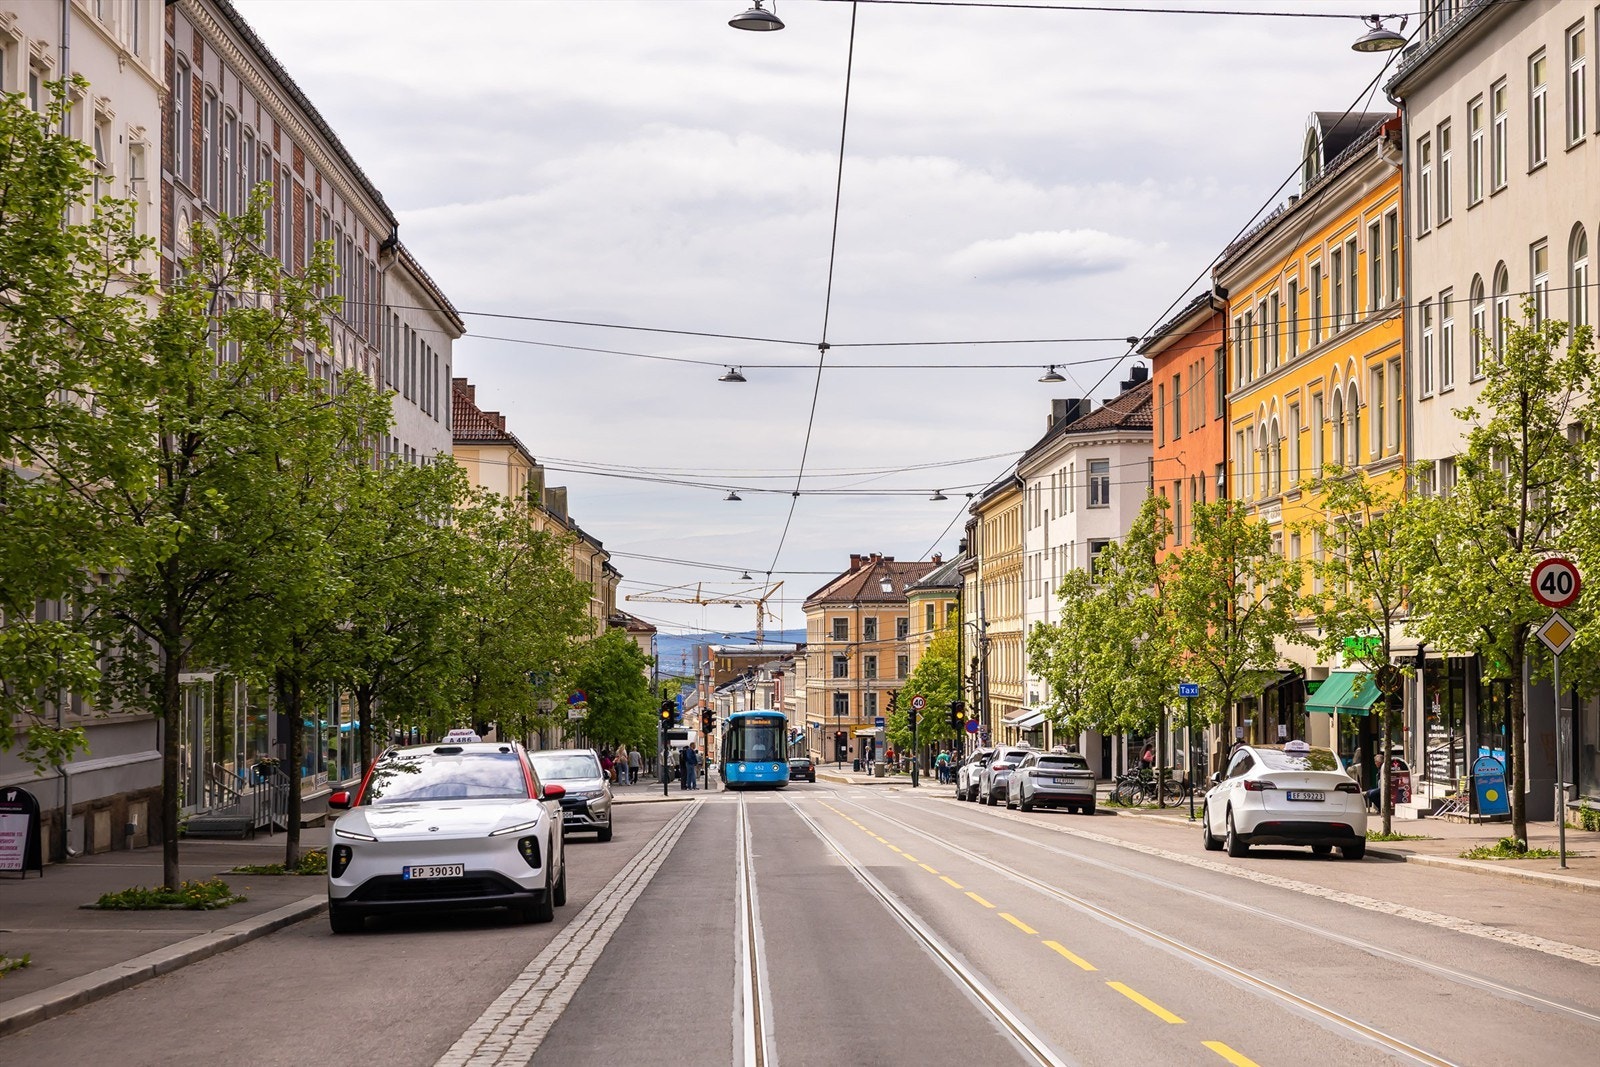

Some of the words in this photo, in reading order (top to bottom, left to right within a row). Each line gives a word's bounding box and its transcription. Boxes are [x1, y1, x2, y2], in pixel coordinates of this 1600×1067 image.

[1540, 571, 1573, 595] 40
[1180, 686, 1198, 694] Taxi
[1303, 792, 1323, 800] 59223
[412, 867, 424, 878] EP
[429, 865, 461, 877] 39030
